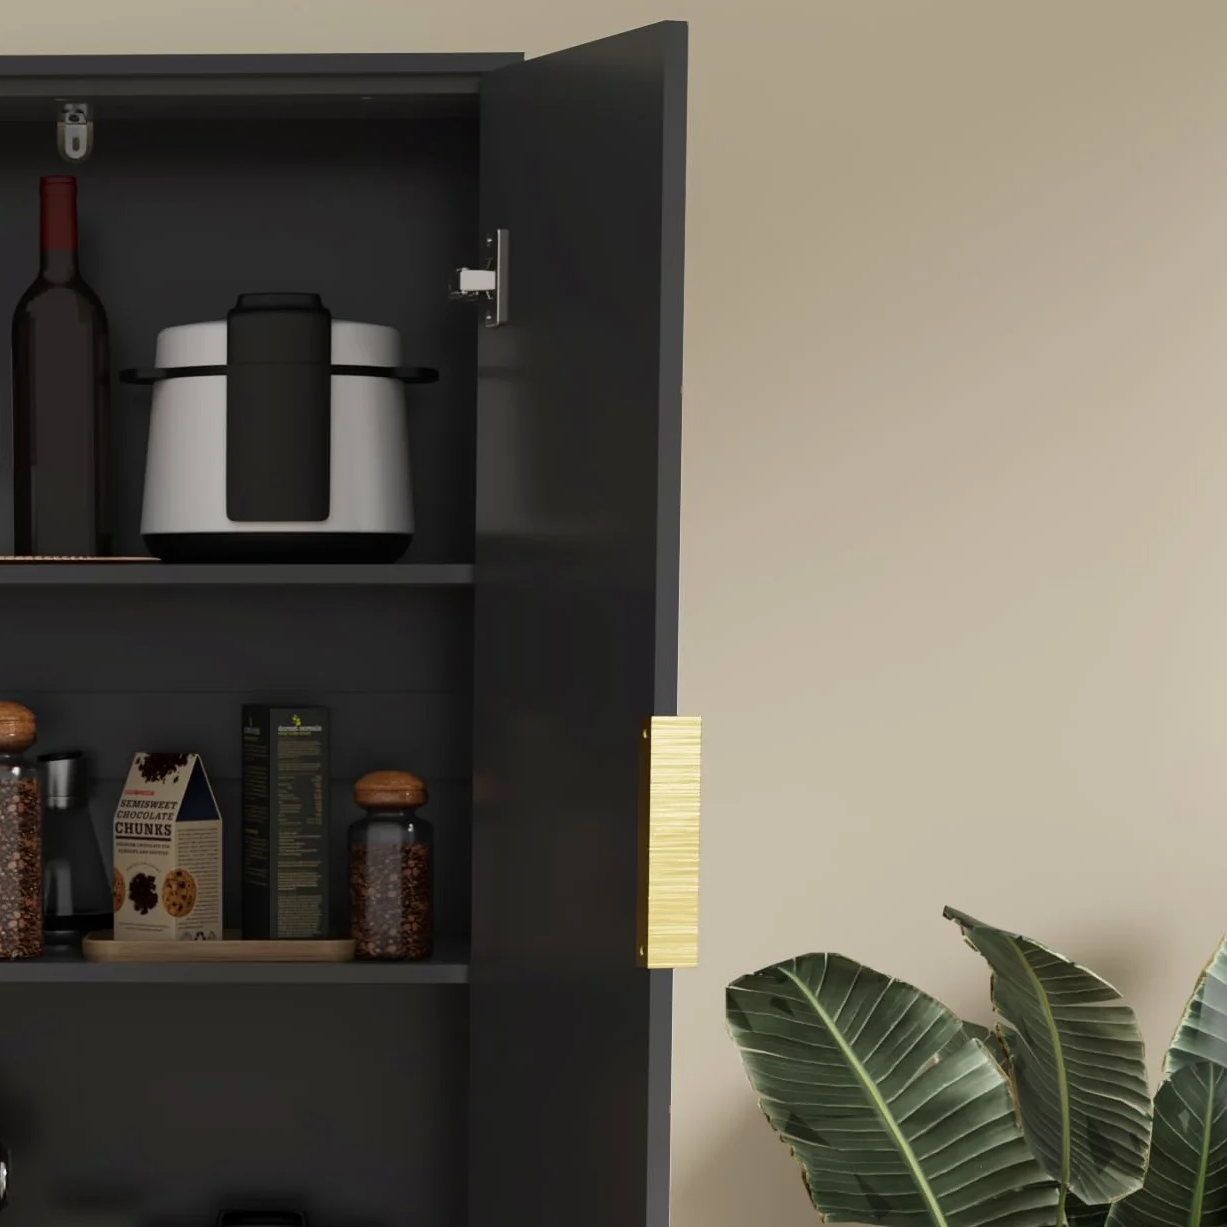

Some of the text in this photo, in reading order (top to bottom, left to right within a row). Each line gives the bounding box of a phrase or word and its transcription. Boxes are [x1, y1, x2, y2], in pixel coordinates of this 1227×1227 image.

[119, 800, 178, 809] SEMISWEET
[116, 810, 174, 820] CHOCOLATE
[115, 822, 172, 836] CHUNKS
